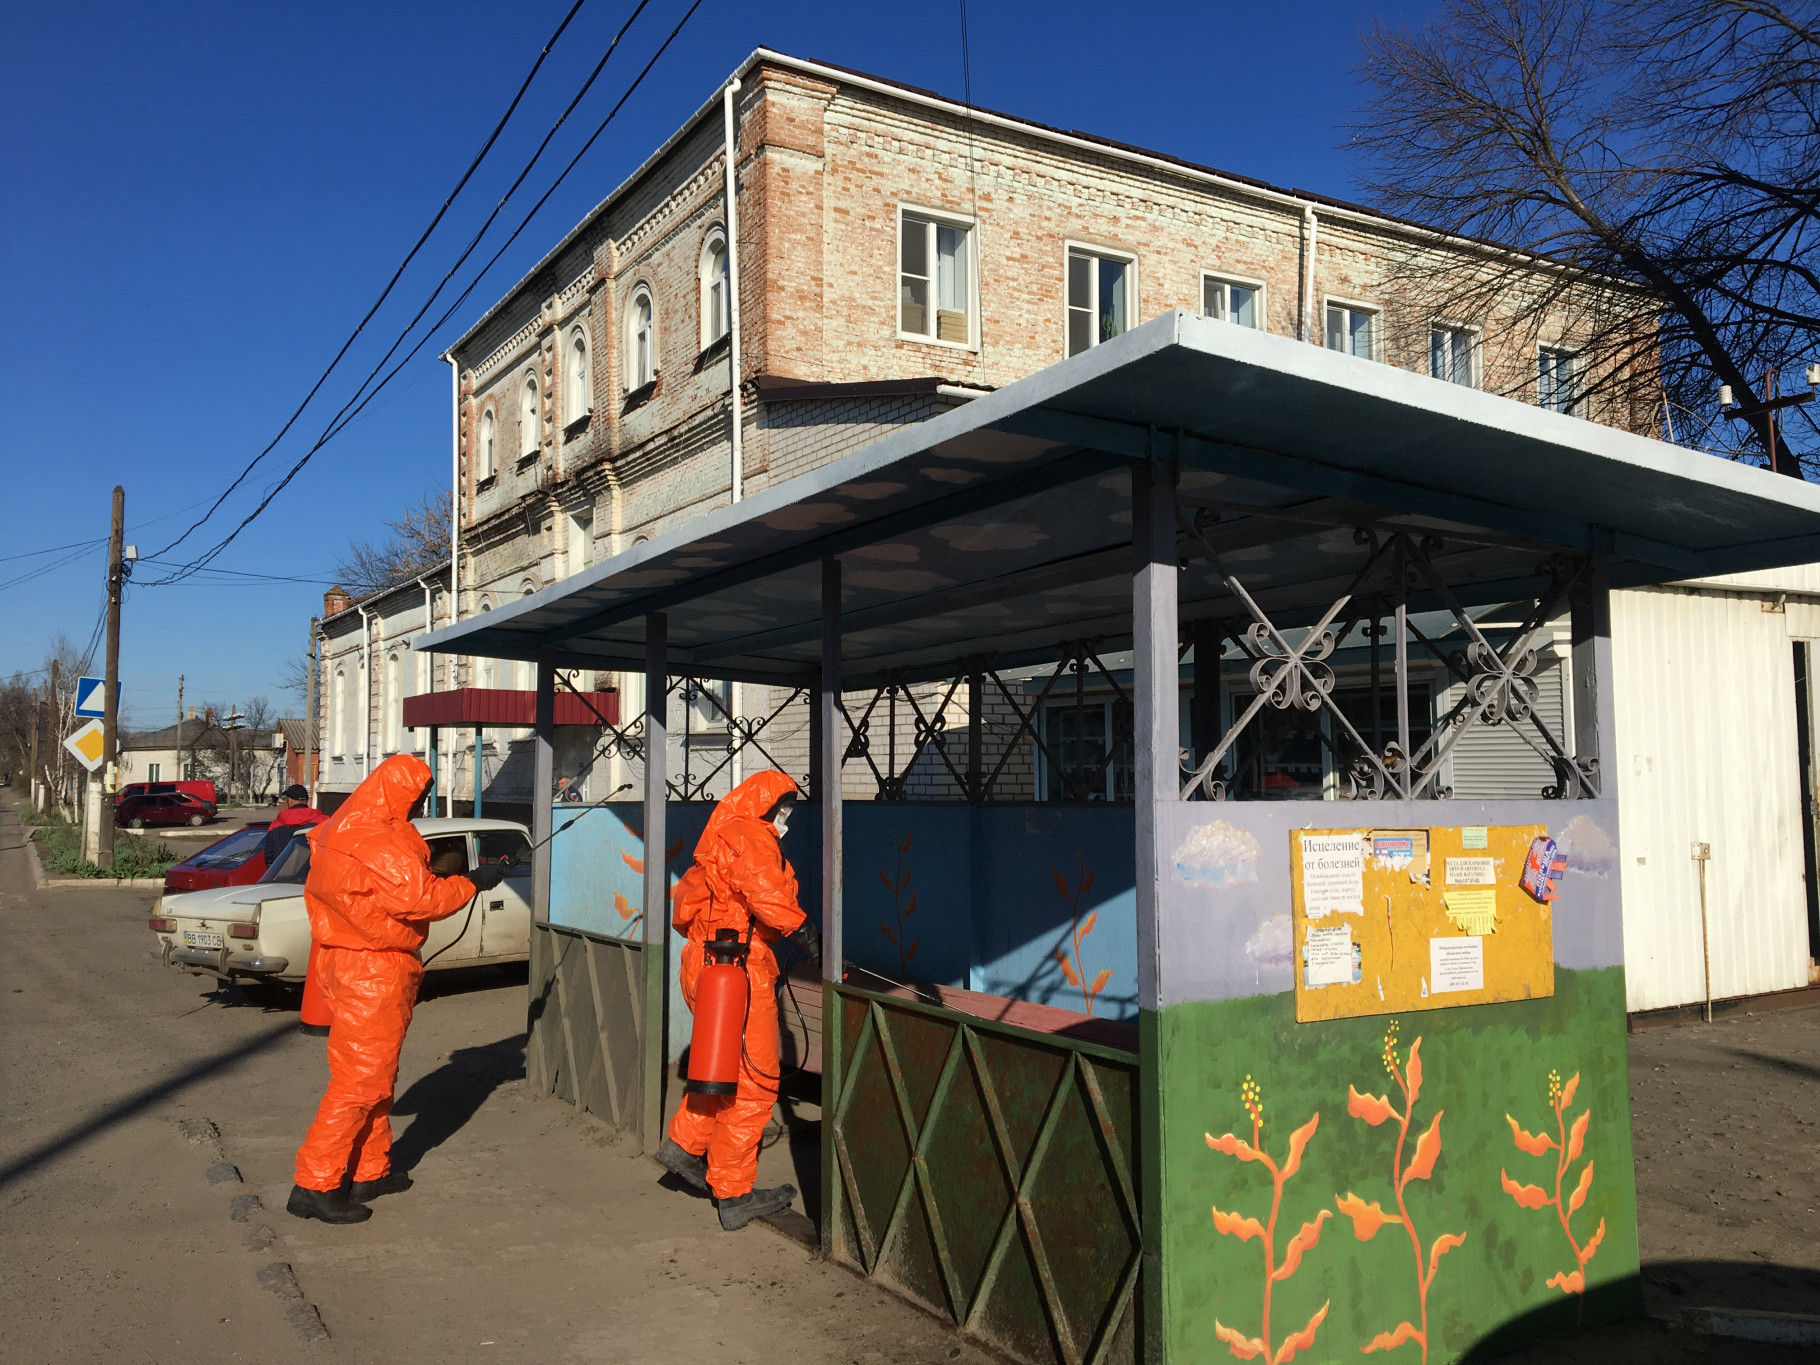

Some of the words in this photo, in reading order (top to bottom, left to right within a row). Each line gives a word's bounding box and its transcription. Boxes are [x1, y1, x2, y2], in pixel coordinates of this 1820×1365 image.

[1304, 840, 1360, 852] Исцеление
[1304, 861, 1315, 870] от
[1317, 857, 1360, 870] болезней
[197, 935, 211, 946] 1903
